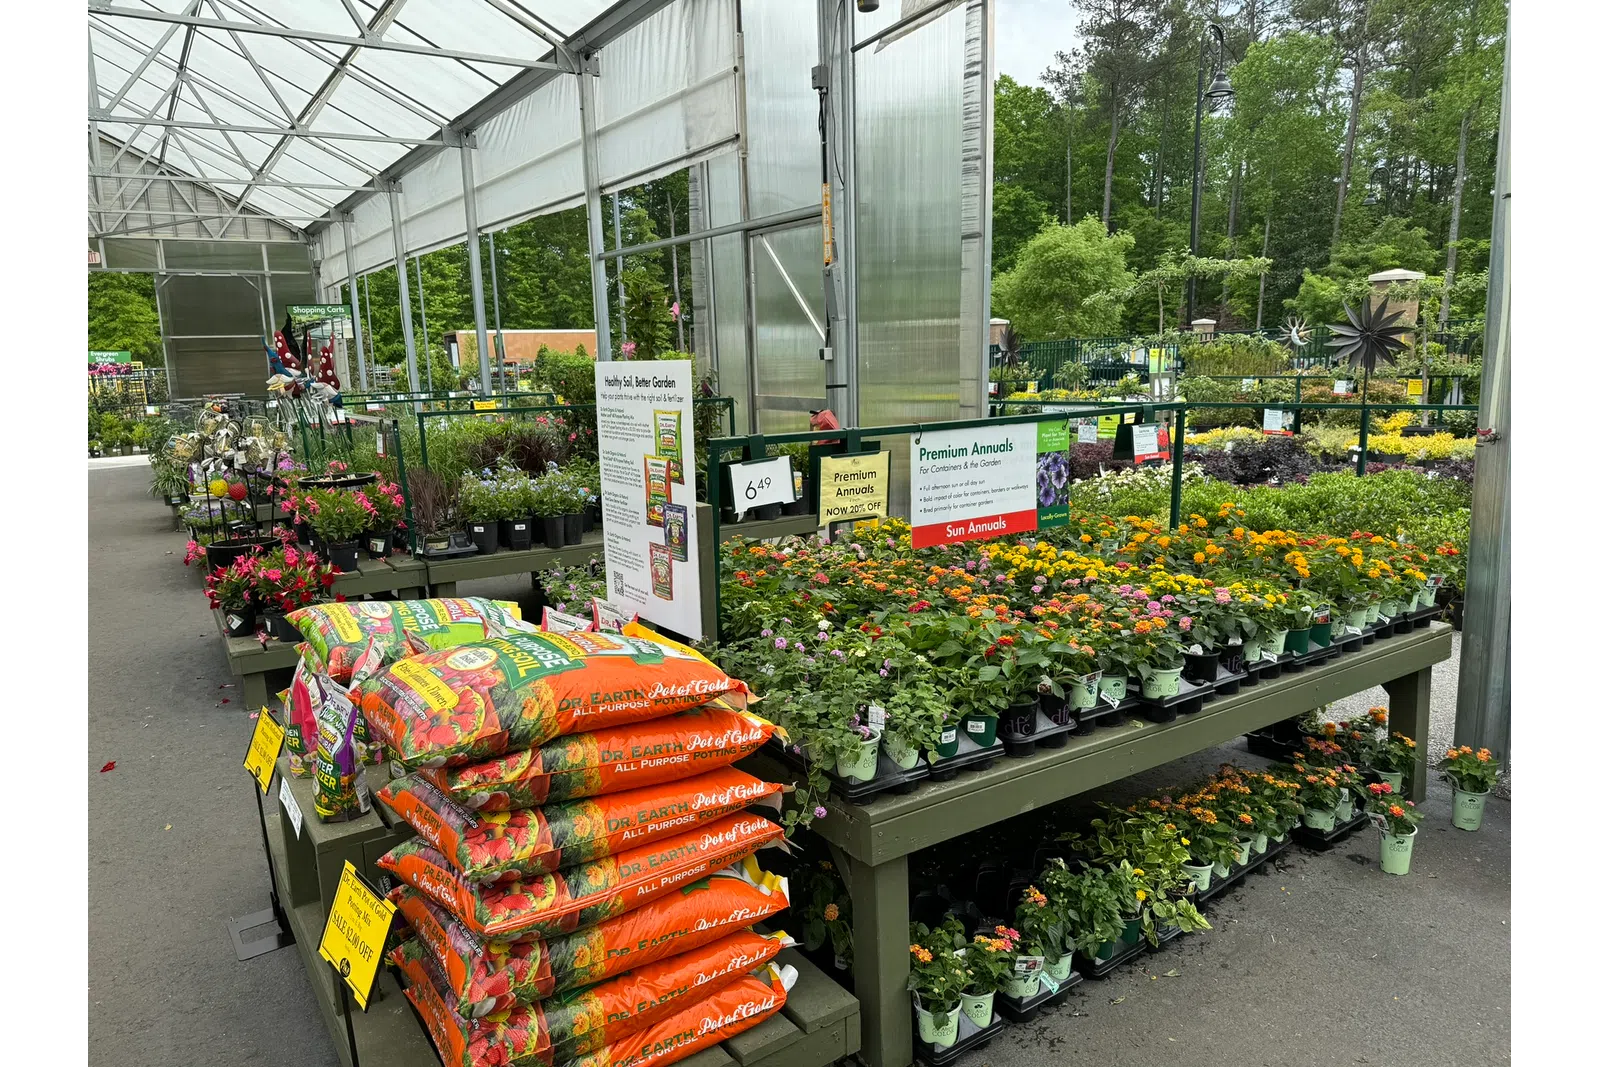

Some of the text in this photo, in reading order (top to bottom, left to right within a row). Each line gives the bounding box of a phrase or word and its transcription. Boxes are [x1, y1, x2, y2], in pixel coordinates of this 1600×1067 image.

[293, 306, 325, 314] Shopping
[604, 375, 676, 390] Healthy Soil, Better Garden
[647, 393, 656, 404] right
[664, 394, 667, 402] &
[668, 394, 684, 402] fertilizer
[920, 438, 1013, 461] Premium Annuals
[834, 470, 877, 482] Premium
[920, 458, 1002, 474] For Containers & the Garden
[836, 484, 874, 498] Annuals
[934, 494, 948, 502] impact
[826, 502, 881, 516] NOW 20% OFF
[934, 505, 952, 514] primarily
[959, 501, 977, 509] container
[978, 500, 994, 508] gardens
[946, 516, 1006, 538] Sun Annuals
[401, 616, 420, 632] MIX
[515, 637, 571, 668] PURPOSE
[508, 652, 541, 678] SOIL
[557, 677, 729, 712] DR. EARTH Pot of Gold
[572, 706, 597, 718] ALL
[599, 700, 650, 714] PURPOSE
[654, 694, 702, 706] POTTING
[1004, 715, 1030, 735] dfc
[601, 728, 762, 764] DR. EARTH Pot of Gold
[614, 763, 638, 773] ALL
[640, 754, 690, 768] PURPOSE
[693, 748, 737, 760] POTTING
[608, 782, 764, 832] DR. EARTH Pot of Gold
[462, 813, 479, 829] QUARTS
[622, 828, 644, 840] ALL
[648, 814, 696, 834] PURPOSE
[700, 802, 742, 819] POTTING
[619, 818, 769, 878] DR. EARTH Pot of Gold
[436, 872, 458, 892] EARH
[637, 884, 658, 896] ALL
[660, 864, 706, 887] PURPOSE
[710, 848, 748, 868] POTTING
[342, 872, 386, 922] Dr. Earth Pot of Gold
[347, 895, 362, 918] Potting
[362, 910, 372, 927] Mix
[733, 904, 770, 921] Gold
[332, 910, 346, 936] SALE
[346, 924, 359, 950] $2.00
[358, 940, 374, 963] OFF
[731, 948, 767, 967] Gold
[641, 1029, 694, 1059] EARTH
[698, 1018, 723, 1036] Pot
[724, 1010, 740, 1025] of
[738, 996, 775, 1018] Gold
